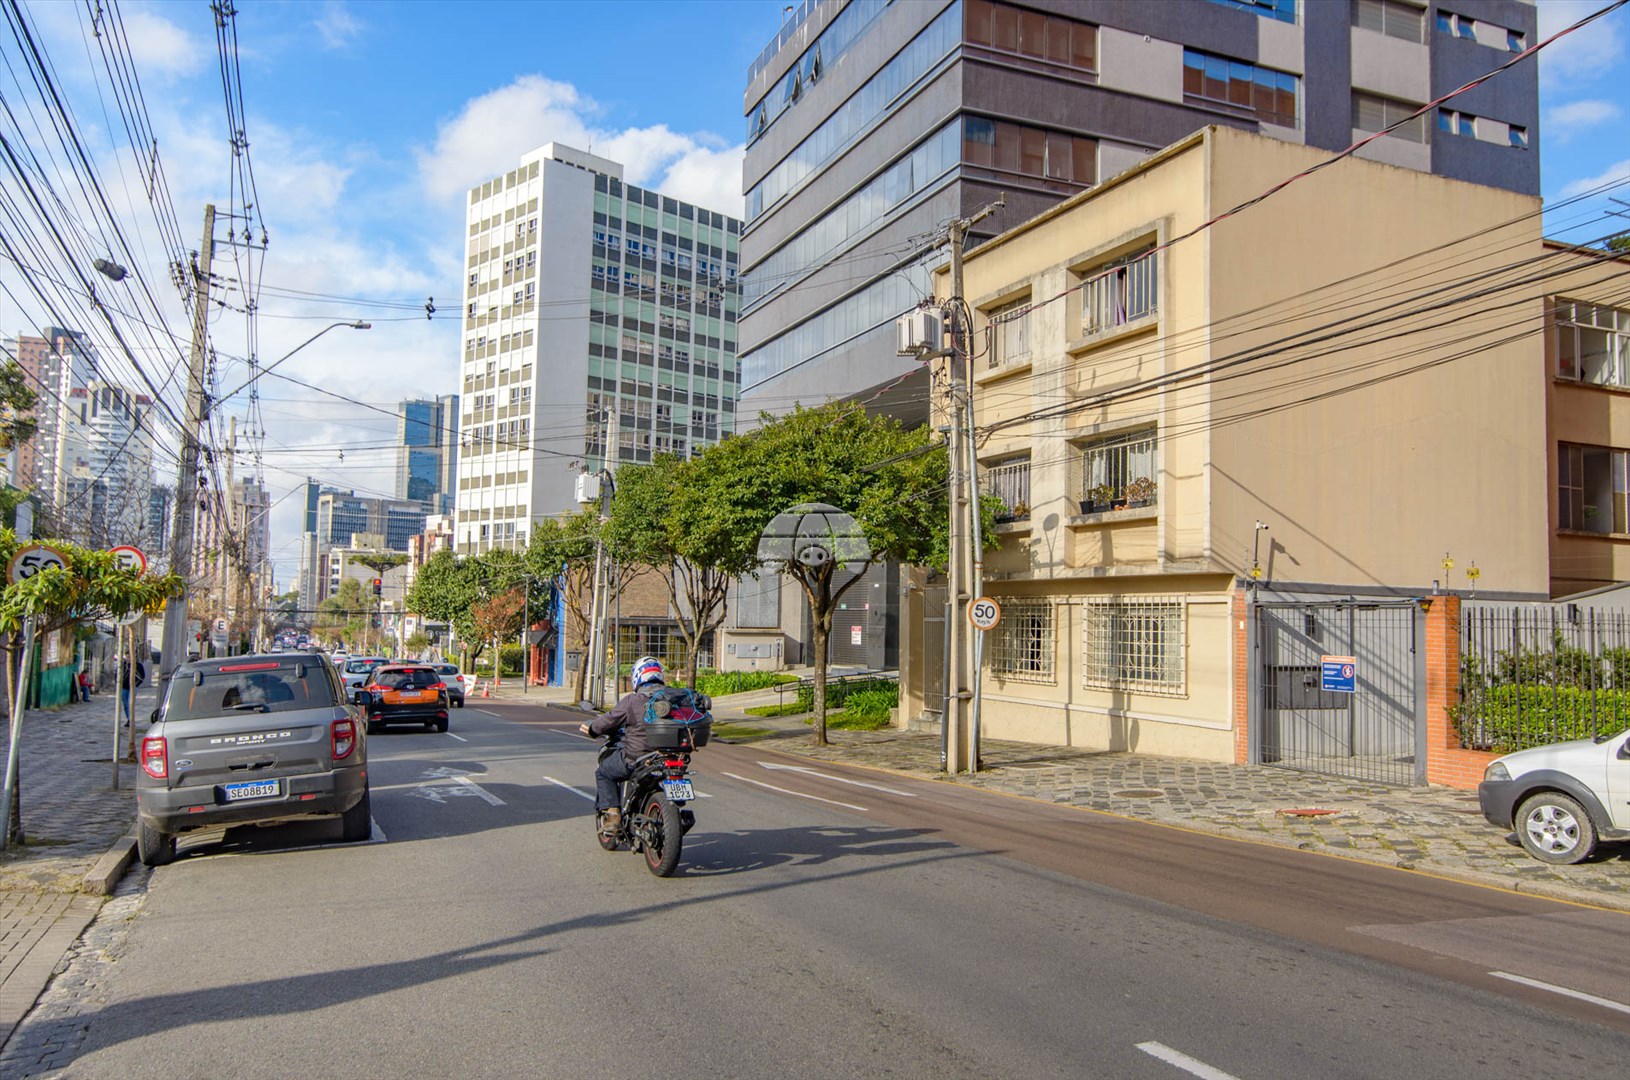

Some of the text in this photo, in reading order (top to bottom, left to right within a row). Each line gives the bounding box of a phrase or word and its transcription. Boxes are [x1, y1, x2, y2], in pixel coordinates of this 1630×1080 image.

[974, 604, 995, 619] 50
[218, 620, 225, 630] E
[210, 731, 292, 745] BRONCO
